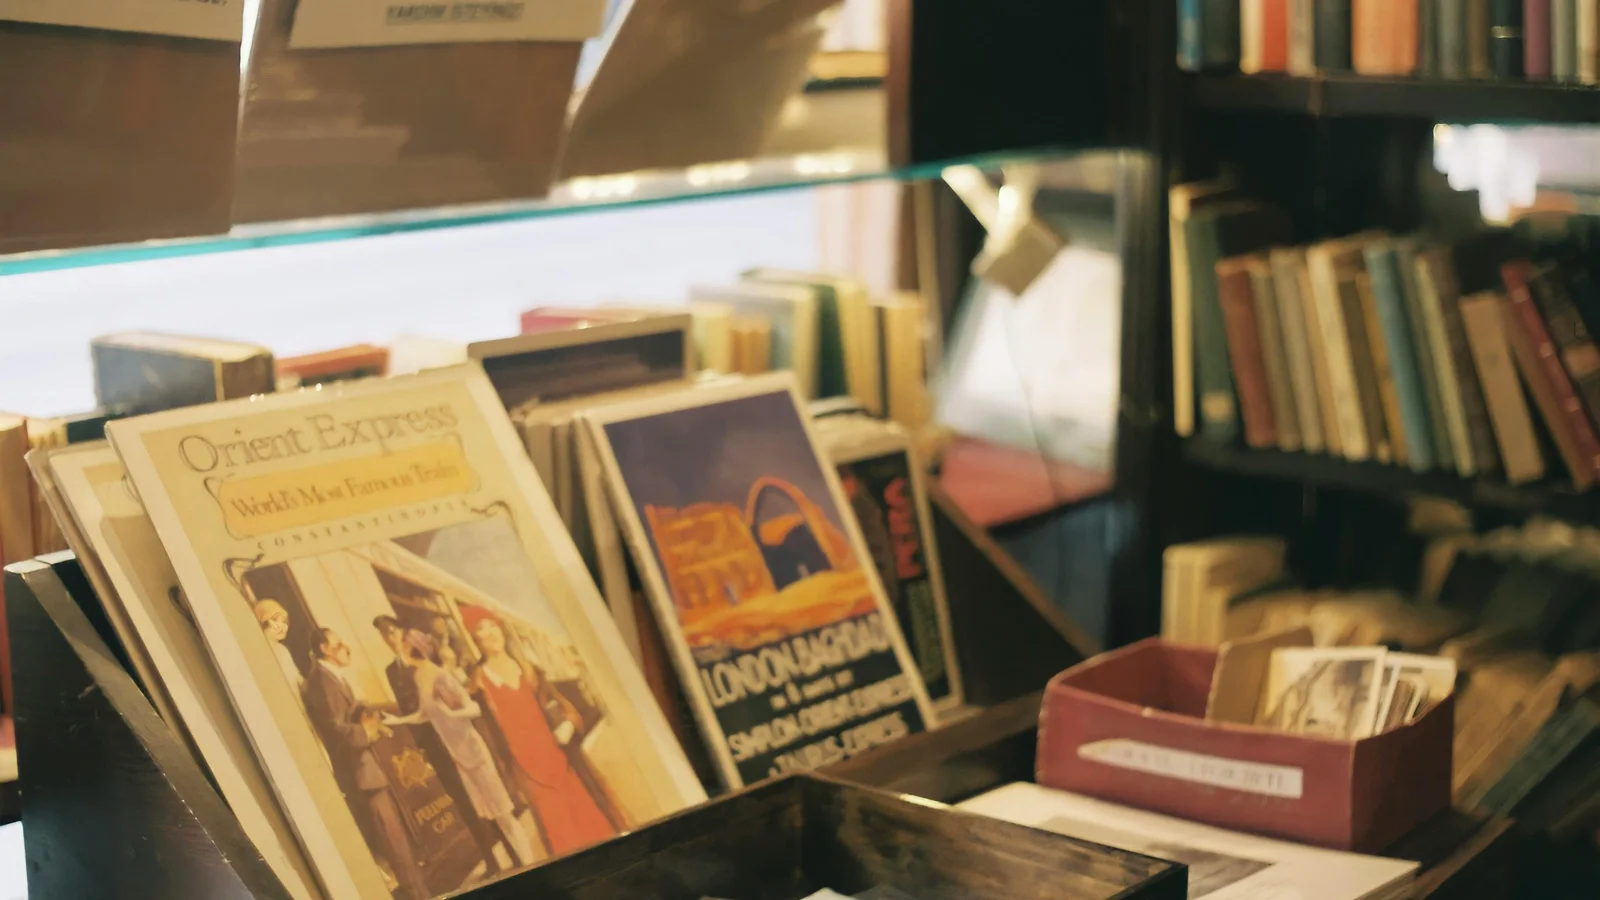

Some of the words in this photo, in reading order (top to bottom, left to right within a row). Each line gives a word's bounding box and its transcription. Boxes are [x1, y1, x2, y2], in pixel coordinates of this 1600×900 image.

[178, 427, 312, 473] Orient
[306, 405, 459, 457] Express
[345, 473, 415, 498] Famous
[410, 462, 460, 483] Train
